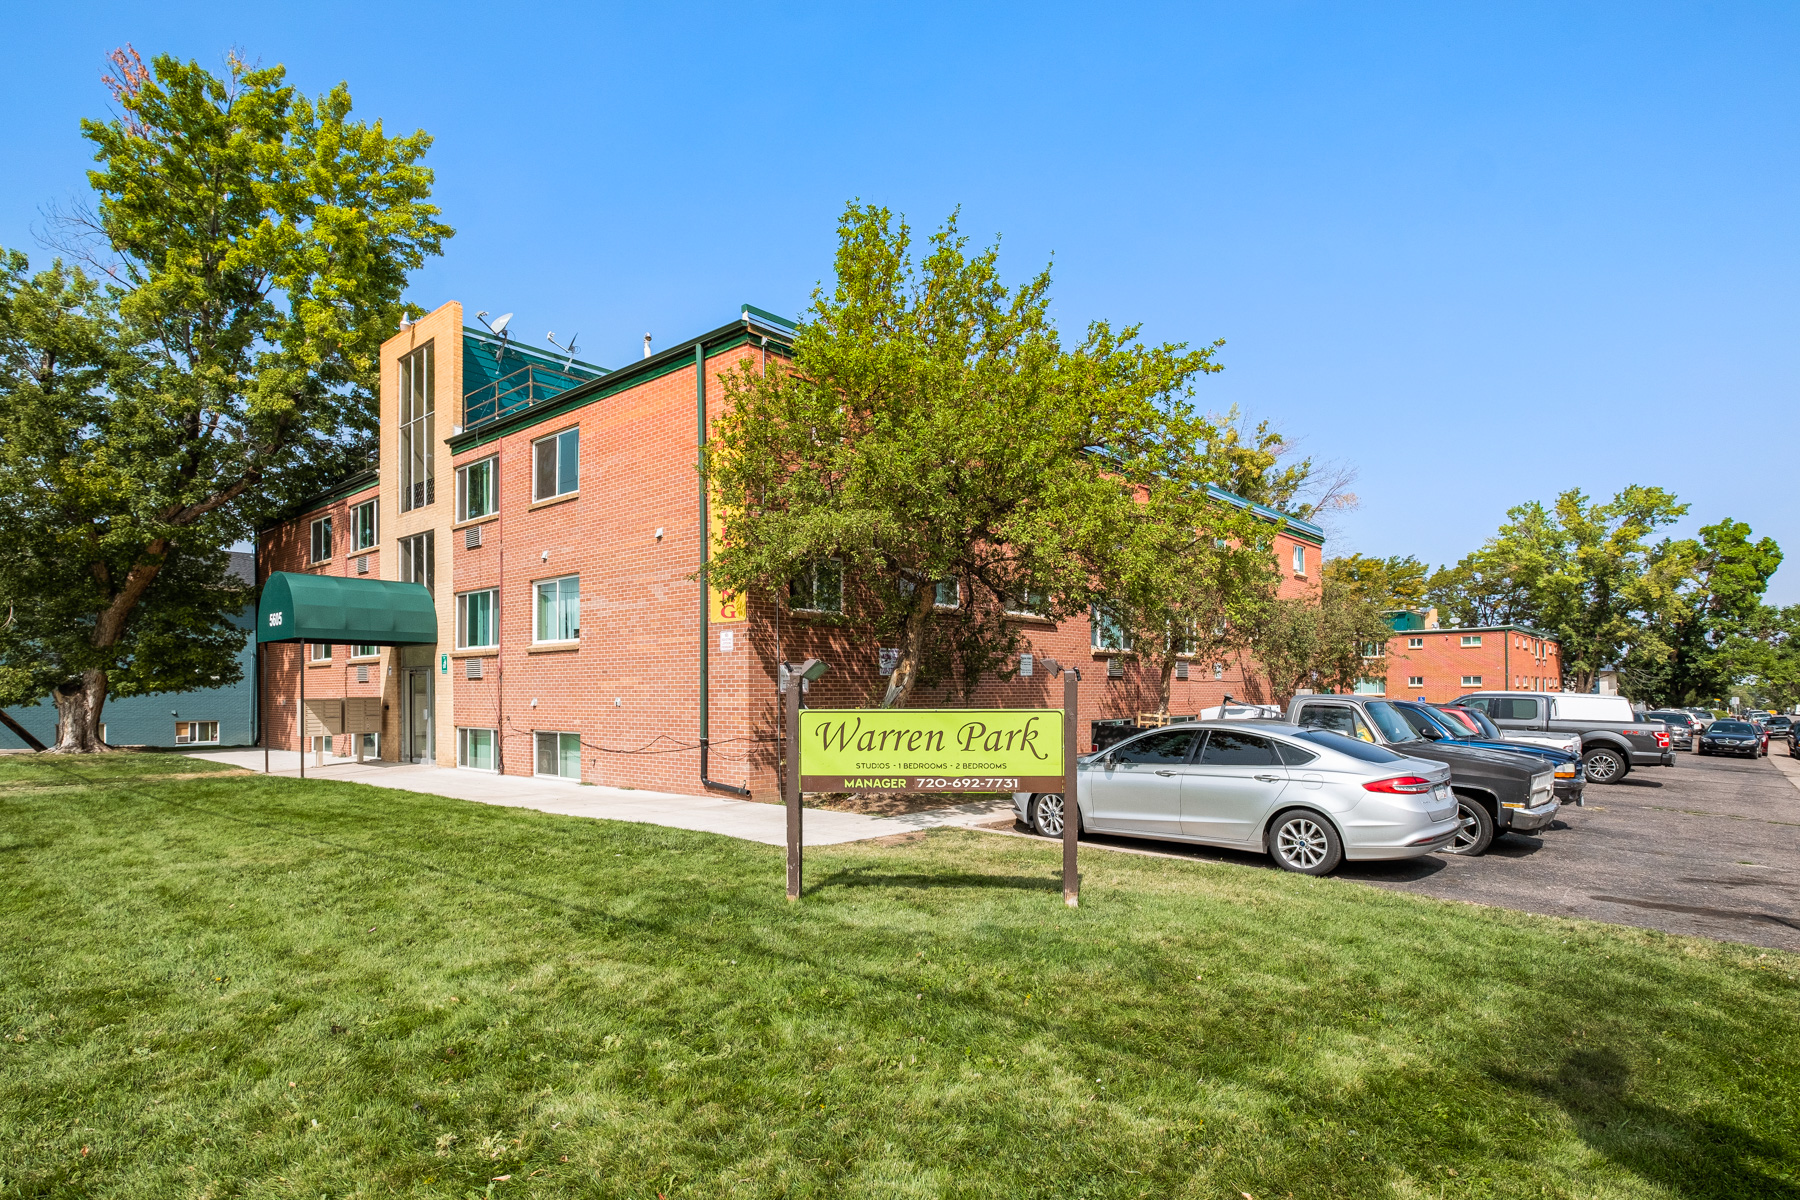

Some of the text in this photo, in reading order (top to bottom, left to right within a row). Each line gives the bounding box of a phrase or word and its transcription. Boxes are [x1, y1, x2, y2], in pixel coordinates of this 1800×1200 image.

[269, 611, 283, 627] 5605
[815, 716, 1049, 760] Warren Park
[855, 762, 891, 770] STUDIOS
[903, 762, 948, 770] BEDROOMS
[955, 762, 961, 770] 2
[962, 762, 1007, 770] BEDROOMS
[844, 778, 1018, 789] MANAGER 720-692-7731
